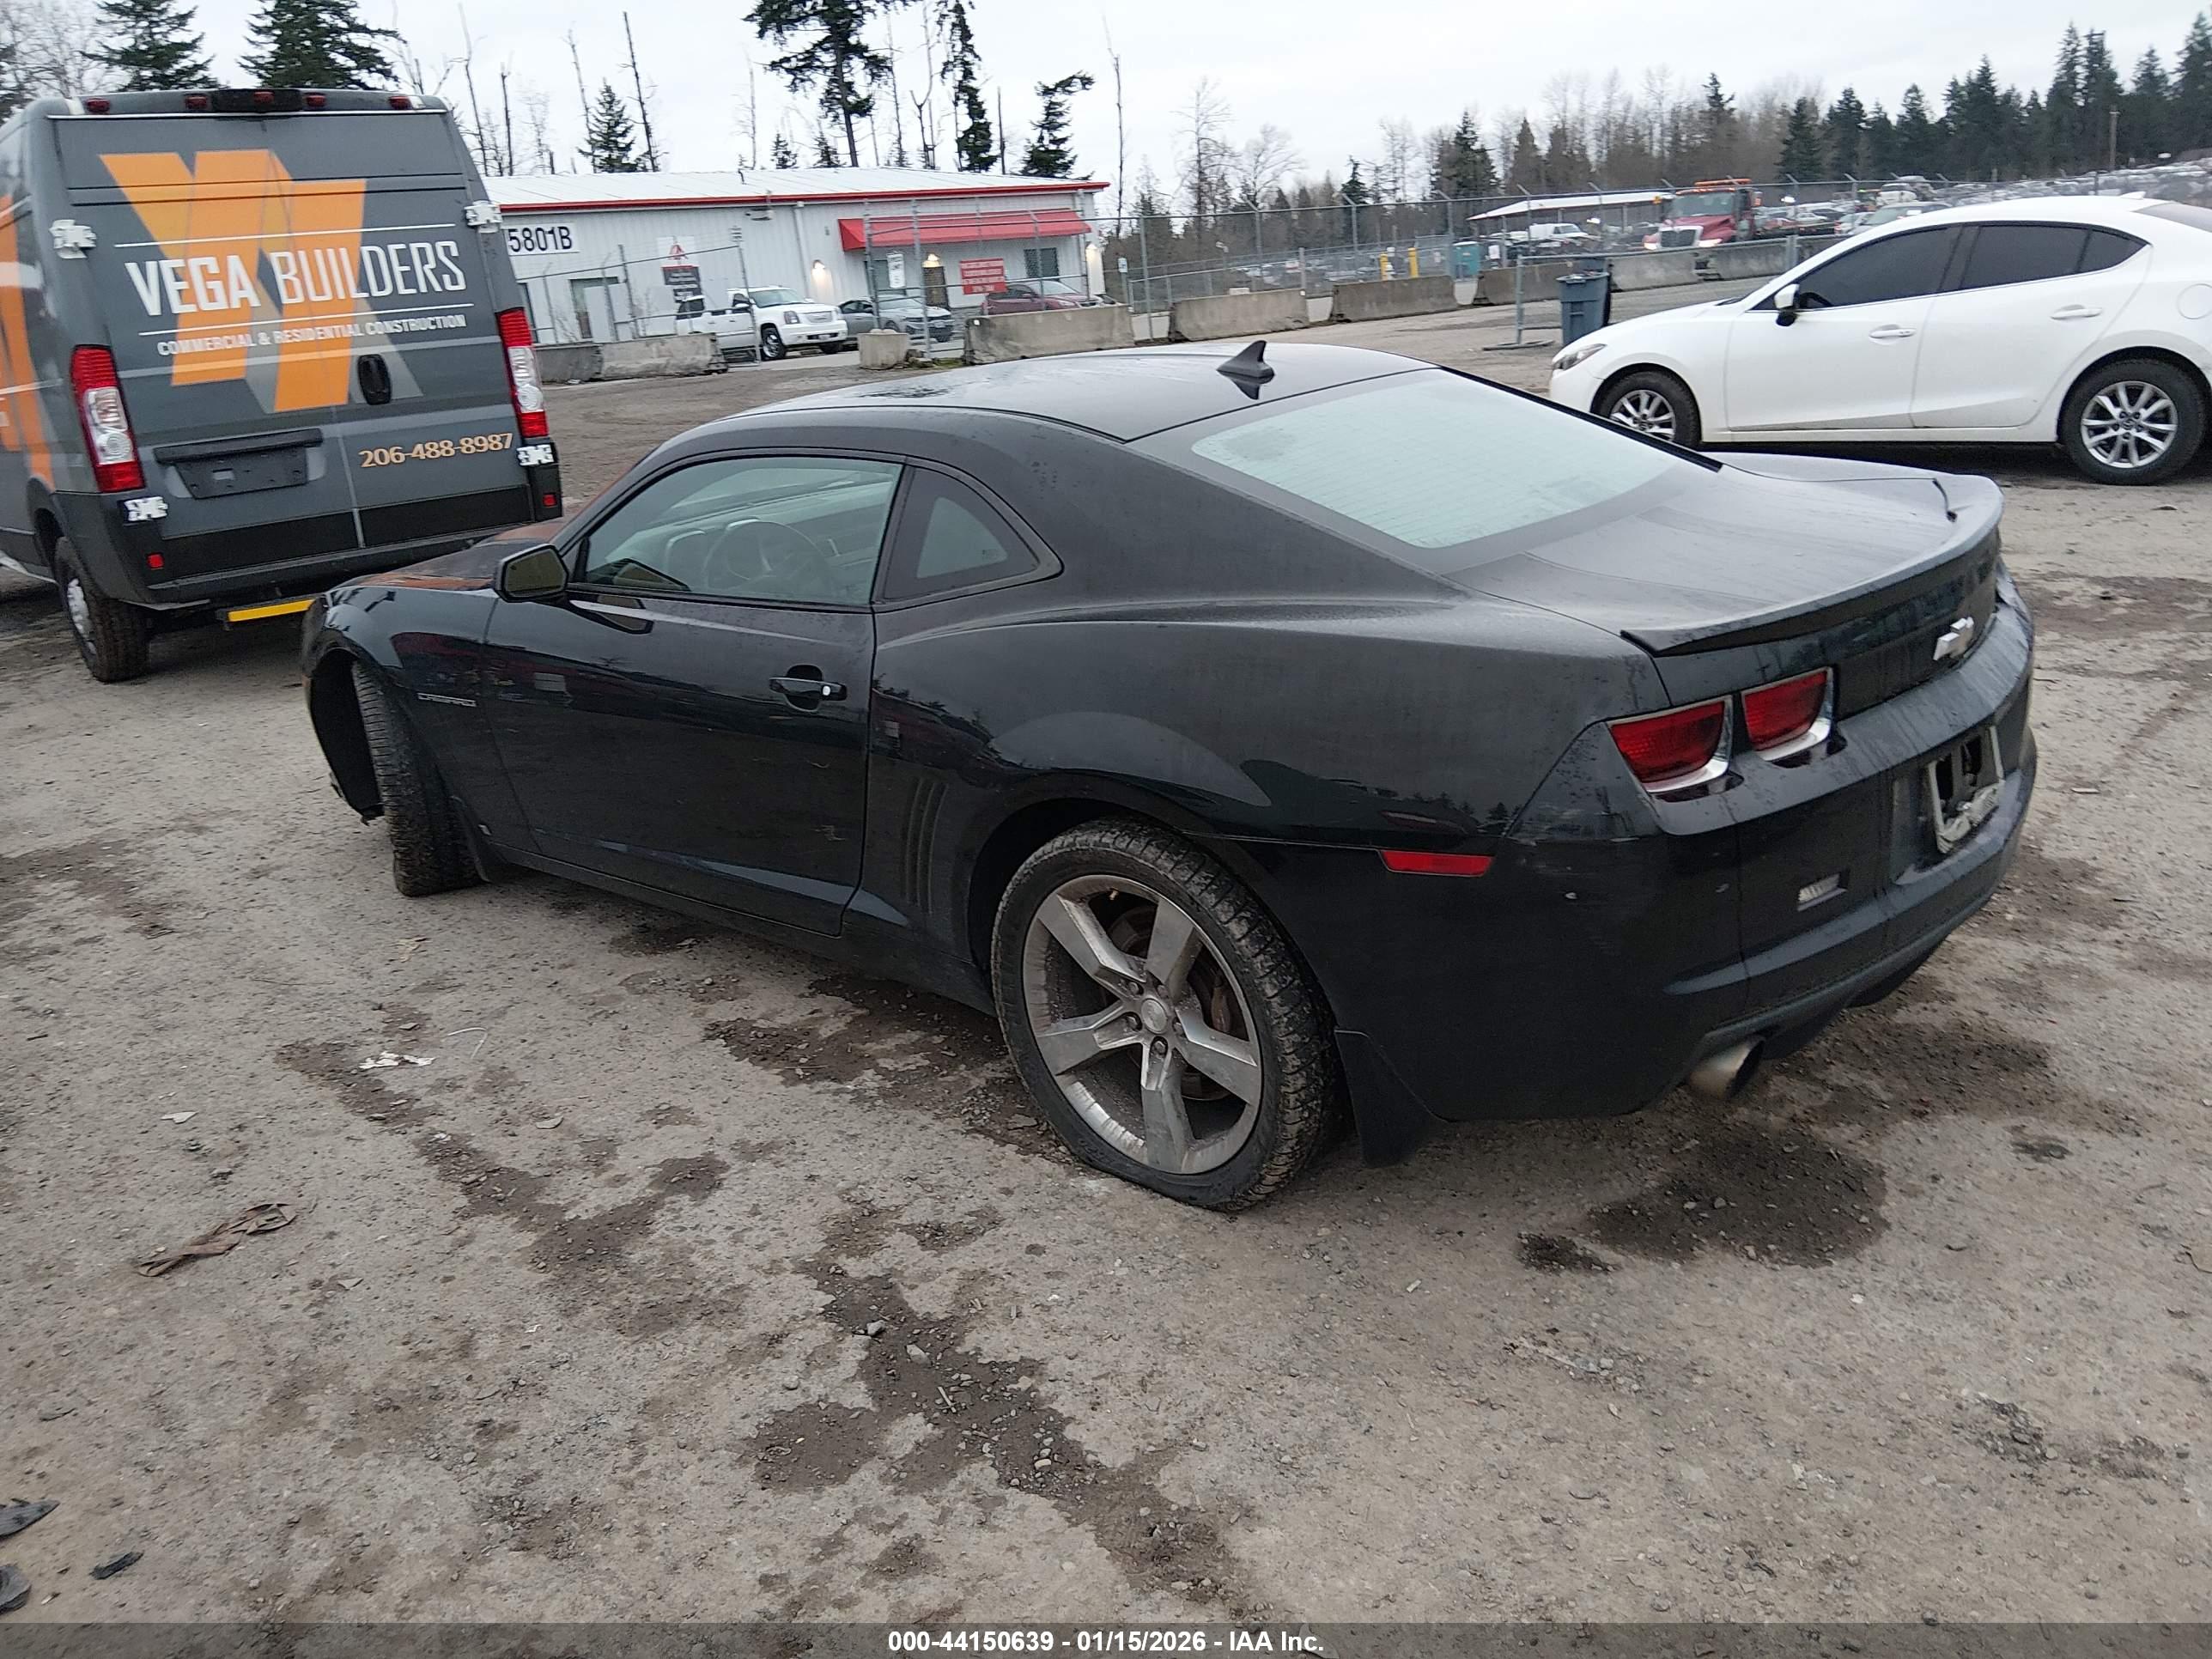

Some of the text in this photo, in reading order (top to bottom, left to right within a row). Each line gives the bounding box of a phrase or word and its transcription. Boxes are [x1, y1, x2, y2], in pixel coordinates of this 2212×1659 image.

[507, 226, 572, 252] 5801B
[125, 240, 466, 316] VEGA BUILDERS
[157, 314, 466, 356] COMMERCIAL & RESIDENTIAL CONSTRUCTION
[358, 433, 514, 468] 206-488-8987
